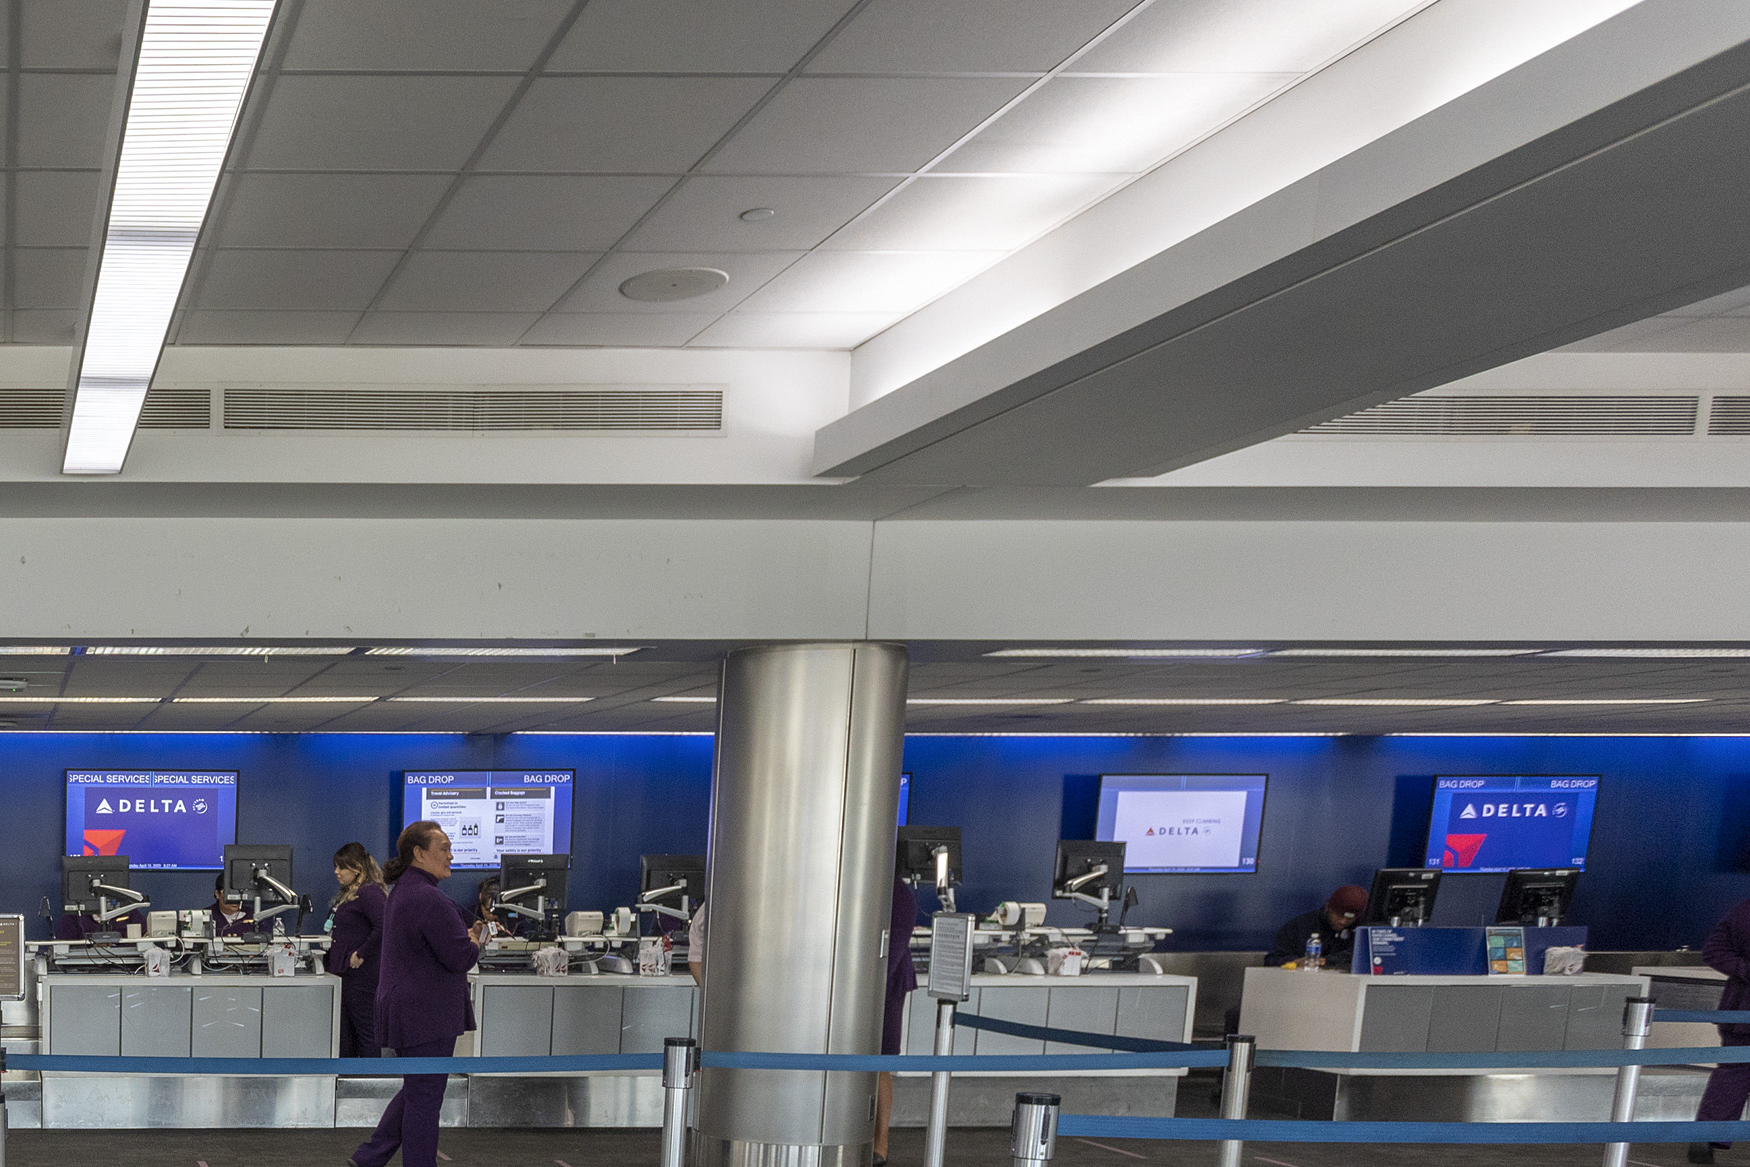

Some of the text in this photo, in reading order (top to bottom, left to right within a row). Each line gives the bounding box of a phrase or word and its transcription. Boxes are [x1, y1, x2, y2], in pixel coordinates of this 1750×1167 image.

[407, 775, 454, 784] BAG DROP
[523, 775, 571, 783] BAG DROP
[1439, 780, 1485, 788] BAG DROP
[1550, 780, 1596, 788] BAG DROP
[119, 799, 187, 813] DELTA
[1481, 803, 1548, 817] DELTA
[1159, 827, 1199, 836] DELTA
